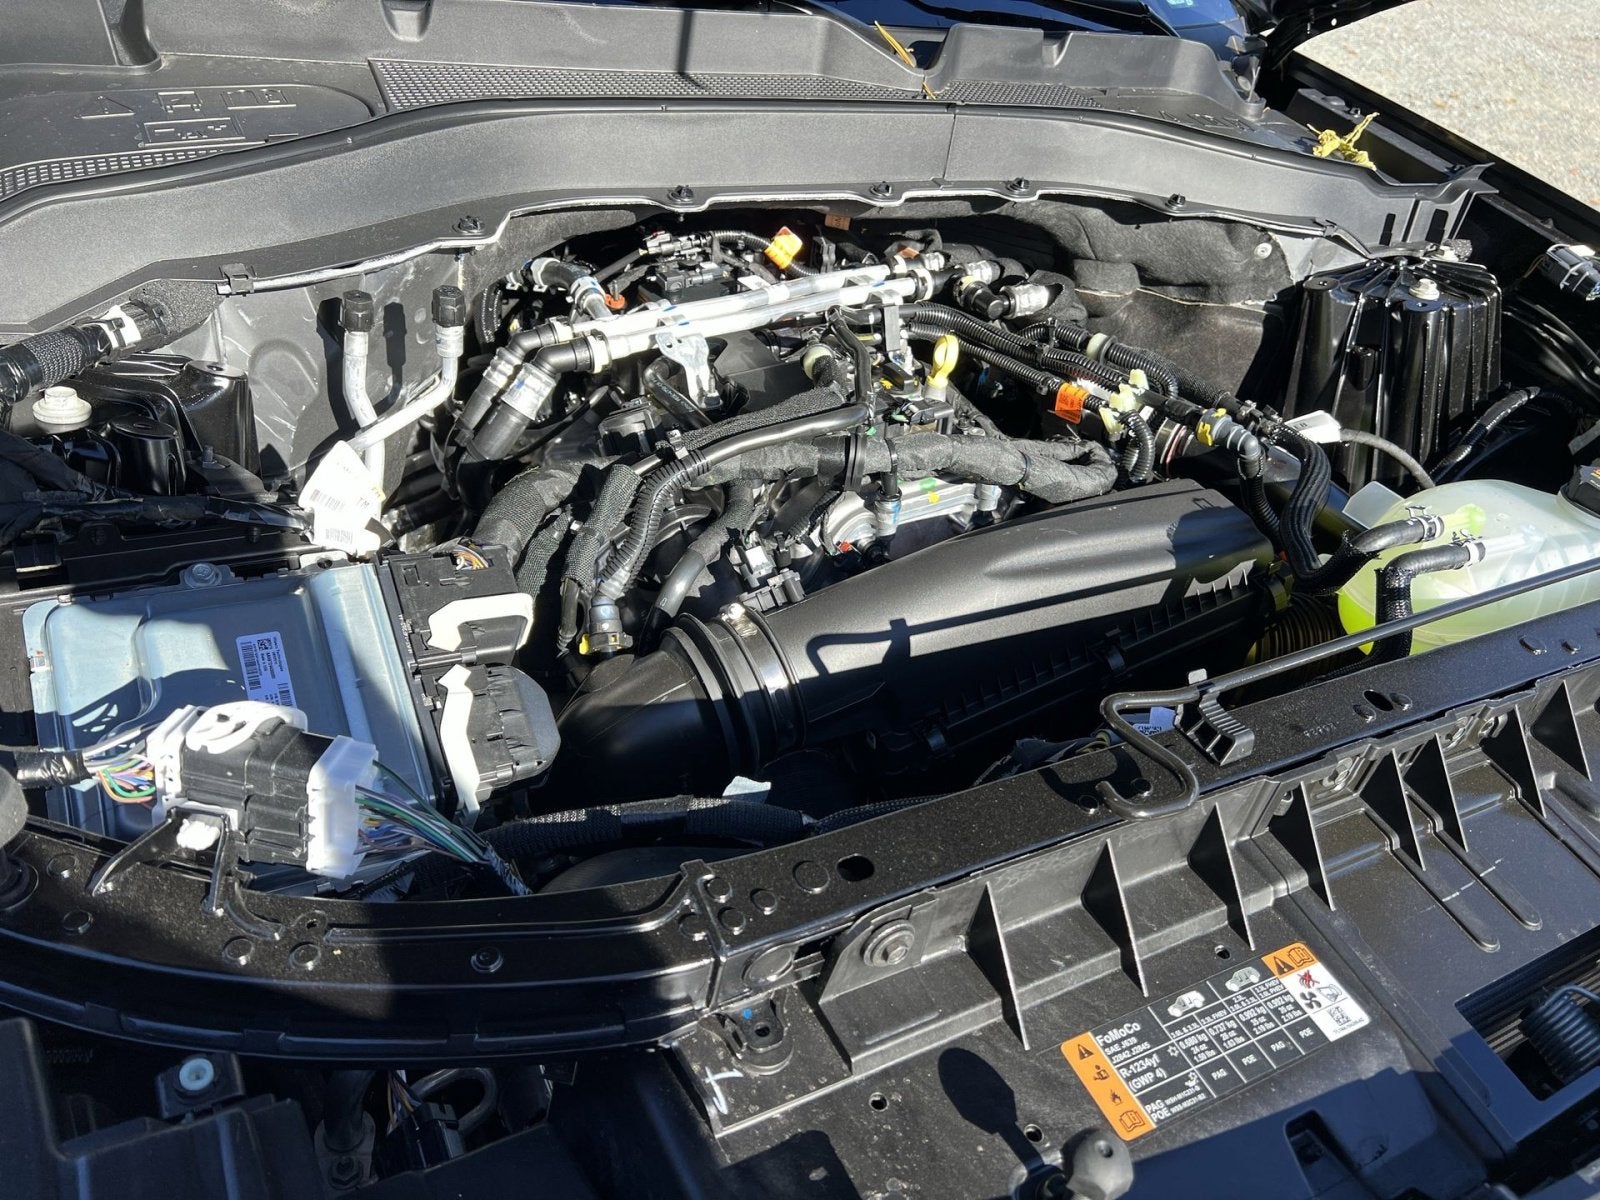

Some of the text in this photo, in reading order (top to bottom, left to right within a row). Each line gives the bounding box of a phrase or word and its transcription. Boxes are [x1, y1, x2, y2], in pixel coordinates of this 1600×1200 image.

[1282, 994, 1295, 1002] kg
[1211, 1009, 1227, 1019] FHEV
[1254, 1006, 1267, 1014] kg
[1291, 1009, 1303, 1017] lbs
[1208, 1020, 1238, 1036] 0.737 kg
[1299, 1027, 1314, 1038] POE
[1095, 1022, 1141, 1047] FoMoCo
[1195, 1033, 1209, 1042] kg
[1233, 1036, 1245, 1044] lbs
[1104, 1036, 1137, 1055] SAE J639
[1270, 1041, 1286, 1052] PAG
[1204, 1049, 1216, 1058] lbs
[1241, 1054, 1257, 1065] POE
[1118, 1053, 1160, 1078] R-1234yf
[1128, 1067, 1167, 1092] (GWP 4)
[1211, 1068, 1227, 1080] PAG
[1144, 1099, 1165, 1114] PAG
[1150, 1107, 1171, 1122] POE
